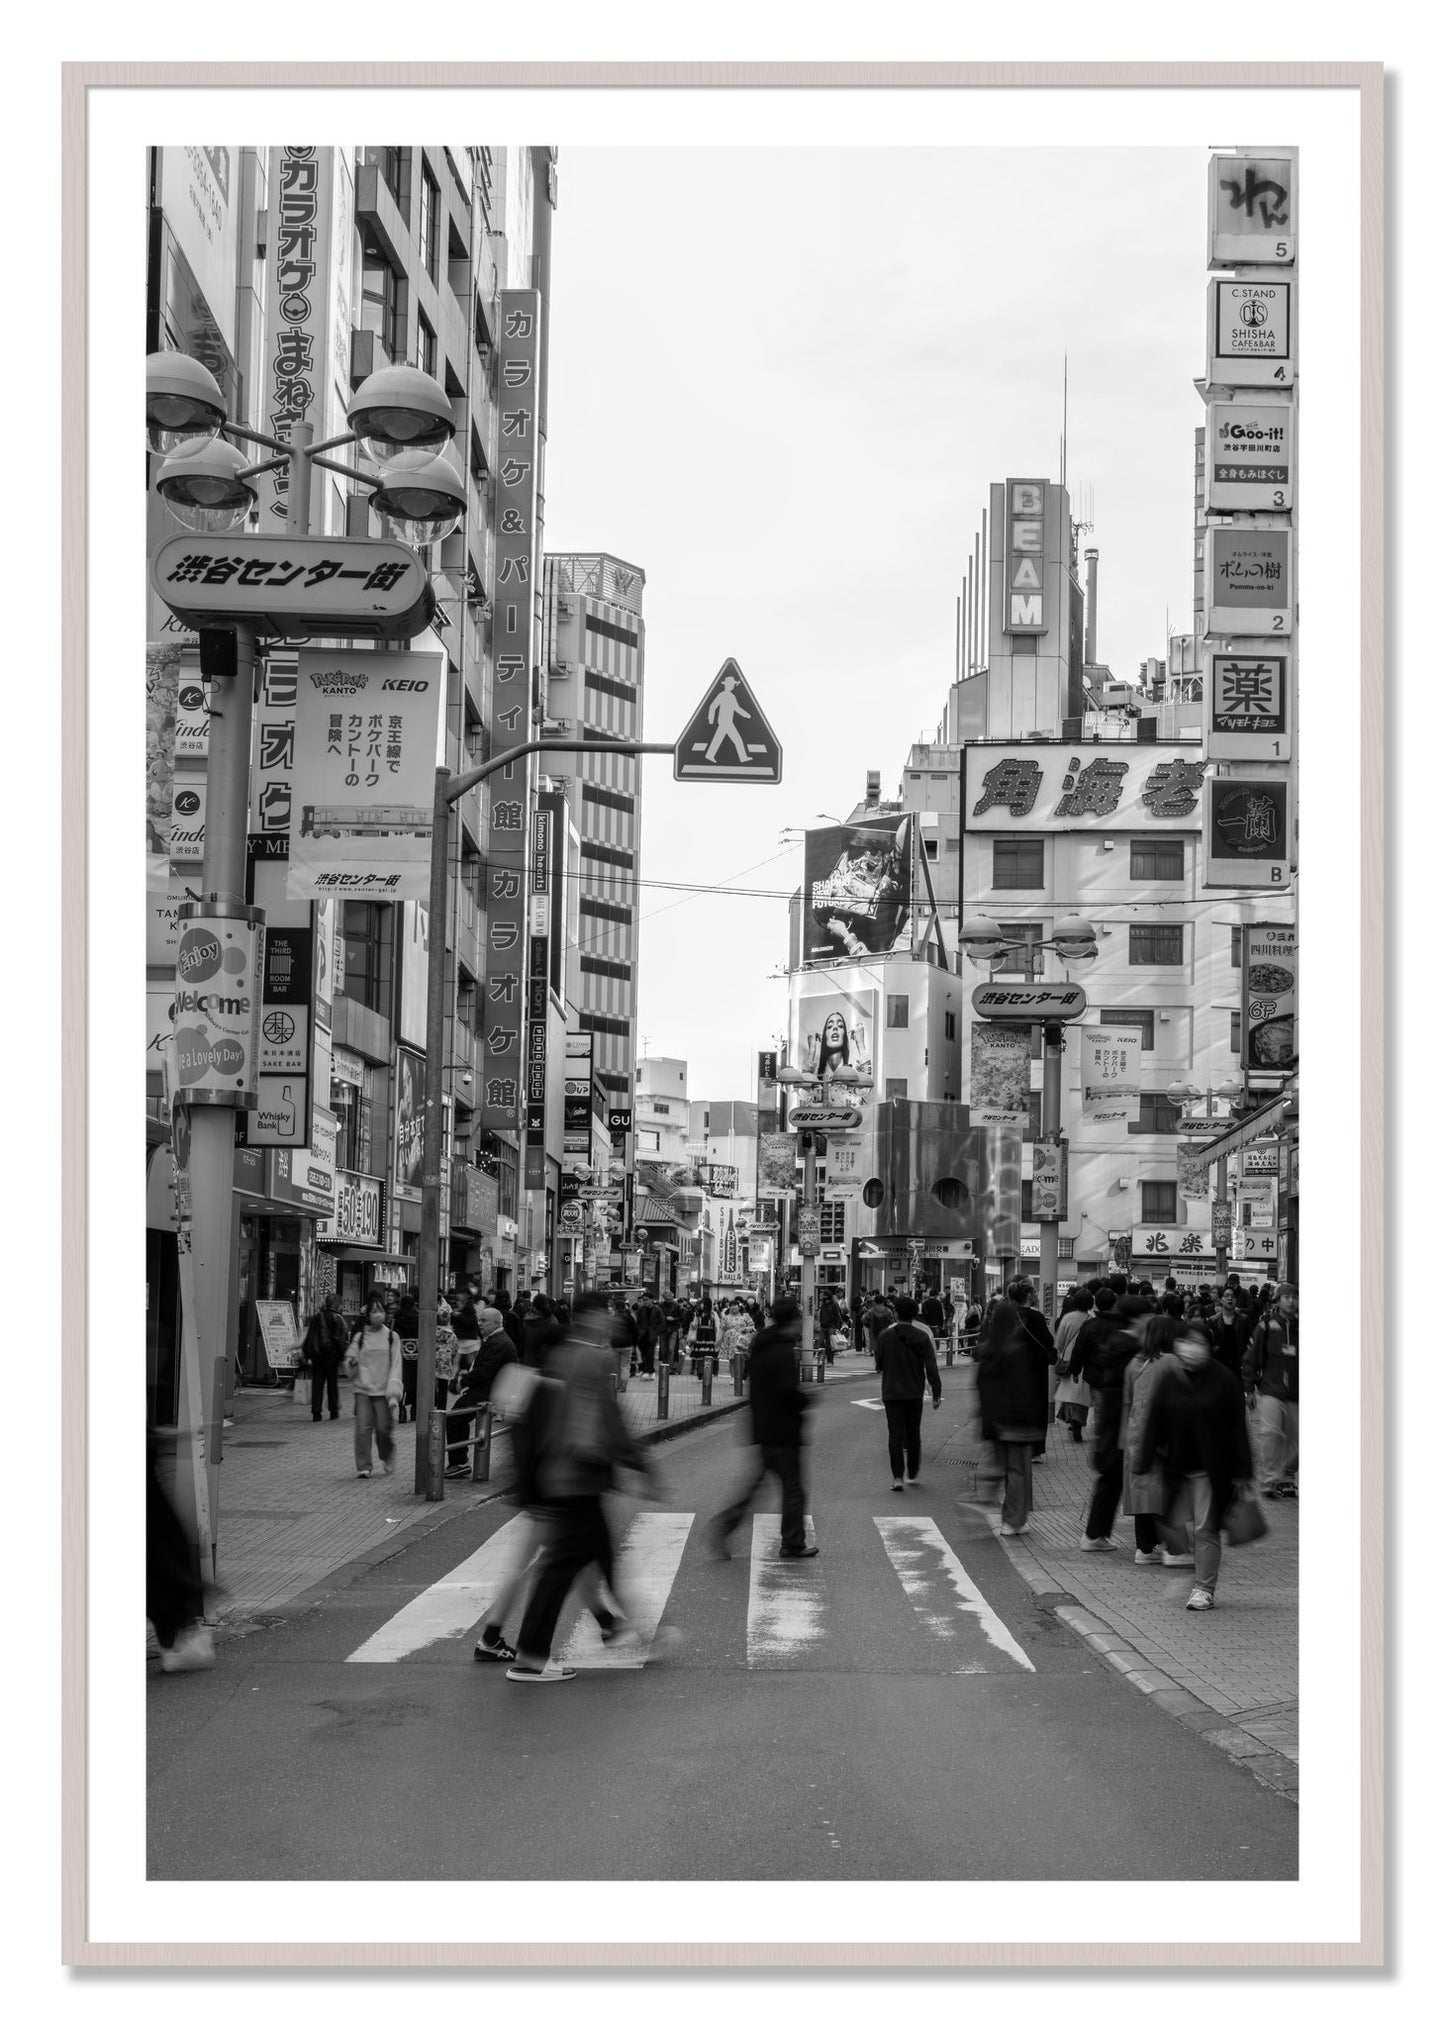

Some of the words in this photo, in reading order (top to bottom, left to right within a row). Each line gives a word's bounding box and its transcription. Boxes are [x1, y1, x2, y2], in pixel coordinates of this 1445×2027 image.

[278, 160, 318, 294] カラオケ
[1275, 242, 1287, 258] 5
[1231, 289, 1276, 298] C.STAND
[1231, 329, 1276, 339] SHISHA
[1231, 340, 1276, 348] CAFE&BAR
[1274, 366, 1286, 382] 4
[1230, 423, 1284, 440] Goo-it!
[1223, 443, 1281, 453] 渋谷宇田川町店
[1218, 468, 1285, 480] 全身もみほぐし
[1272, 490, 1285, 506] 3
[1012, 484, 1043, 626] BEAM
[166, 554, 411, 592] 渋谷センター街
[1219, 560, 1282, 580] ポムの樹
[1229, 583, 1274, 591] Pomme-no-ki
[1272, 615, 1284, 631] 2
[381, 679, 429, 692] KEIO
[1222, 662, 1273, 713] 薬
[1216, 716, 1278, 731] マツモトキヨシ
[327, 714, 343, 756] 冒険へ
[179, 741, 204, 750] 渋谷店
[345, 714, 362, 787] カントーの
[386, 714, 403, 773] 京王線で
[1272, 740, 1280, 756] 1
[972, 758, 1204, 817] 角海老
[537, 815, 546, 851] kimono
[175, 846, 200, 855] 渋谷店
[314, 873, 402, 886] 渋谷センター街
[536, 856, 545, 889] hearts
[1270, 866, 1283, 882] B
[179, 940, 219, 976] Enjoy
[270, 947, 292, 955] THIRD
[1250, 944, 1295, 956] 四川料理
[273, 985, 287, 993] BAR
[176, 990, 251, 1016] Welcome
[979, 992, 1080, 1005] 渋谷センター街
[1249, 1001, 1277, 1020] 6F
[192, 1047, 222, 1066] Lovely
[223, 1048, 243, 1062] Day!
[258, 1112, 290, 1123] Whisky
[611, 1115, 630, 1126] GU
[793, 1112, 853, 1121] 渋谷センター街
[257, 1121, 277, 1129] Bank
[1180, 1122, 1236, 1130] 渋谷センター街
[361, 1191, 378, 1237] 190
[727, 1231, 735, 1272] BEER
